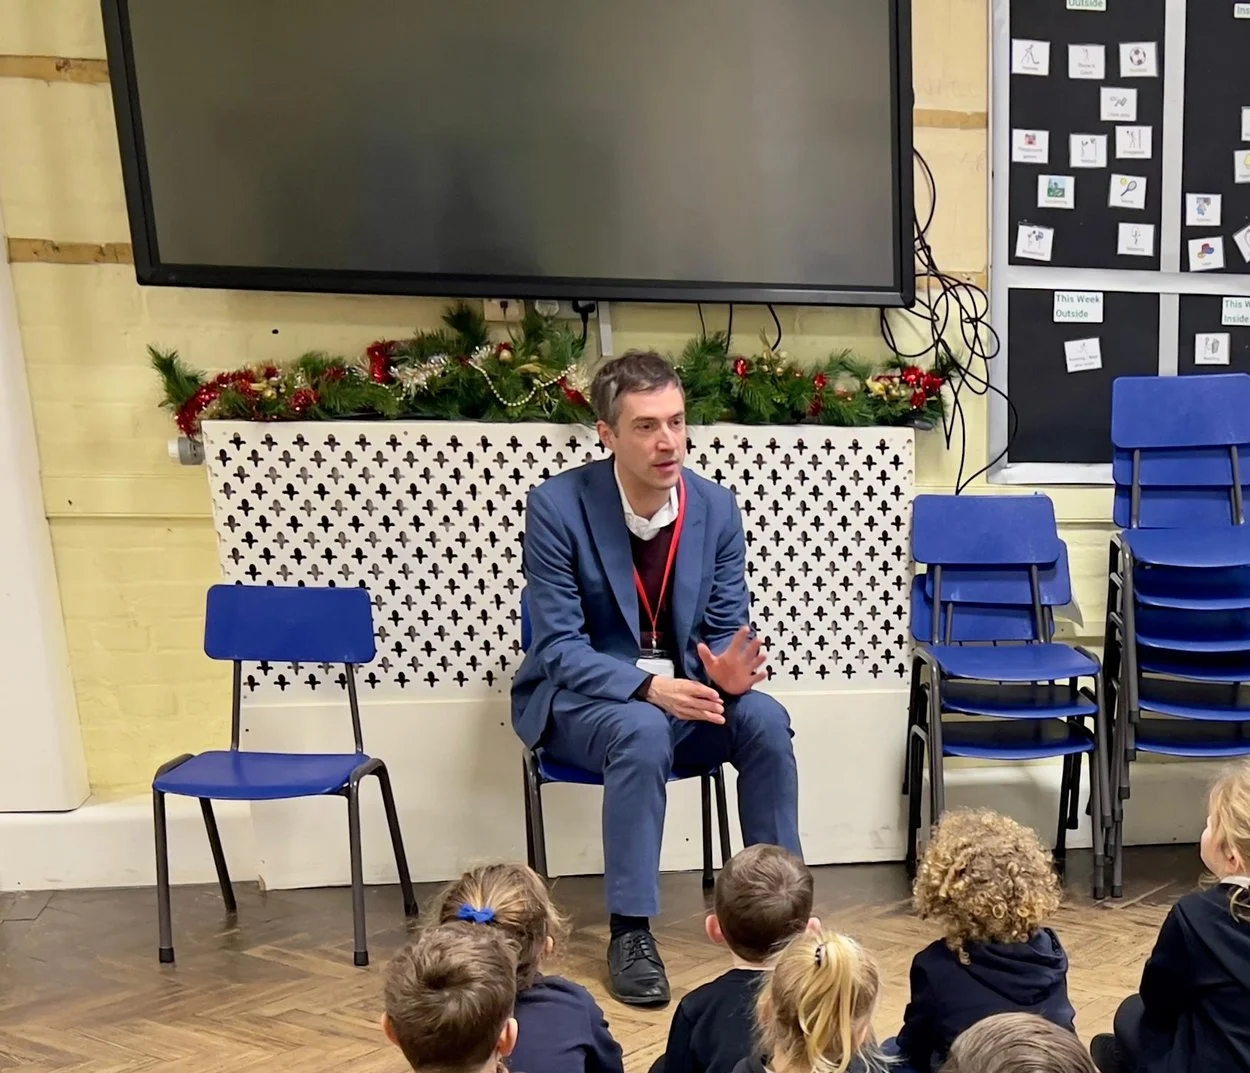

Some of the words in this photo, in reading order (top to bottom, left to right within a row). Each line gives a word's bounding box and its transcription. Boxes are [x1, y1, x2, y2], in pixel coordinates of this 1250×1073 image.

[1056, 294, 1074, 303] This
[1077, 294, 1101, 304] Week
[1225, 299, 1242, 309] This
[1055, 308, 1089, 318] Outside
[1223, 313, 1249, 324] Inside
